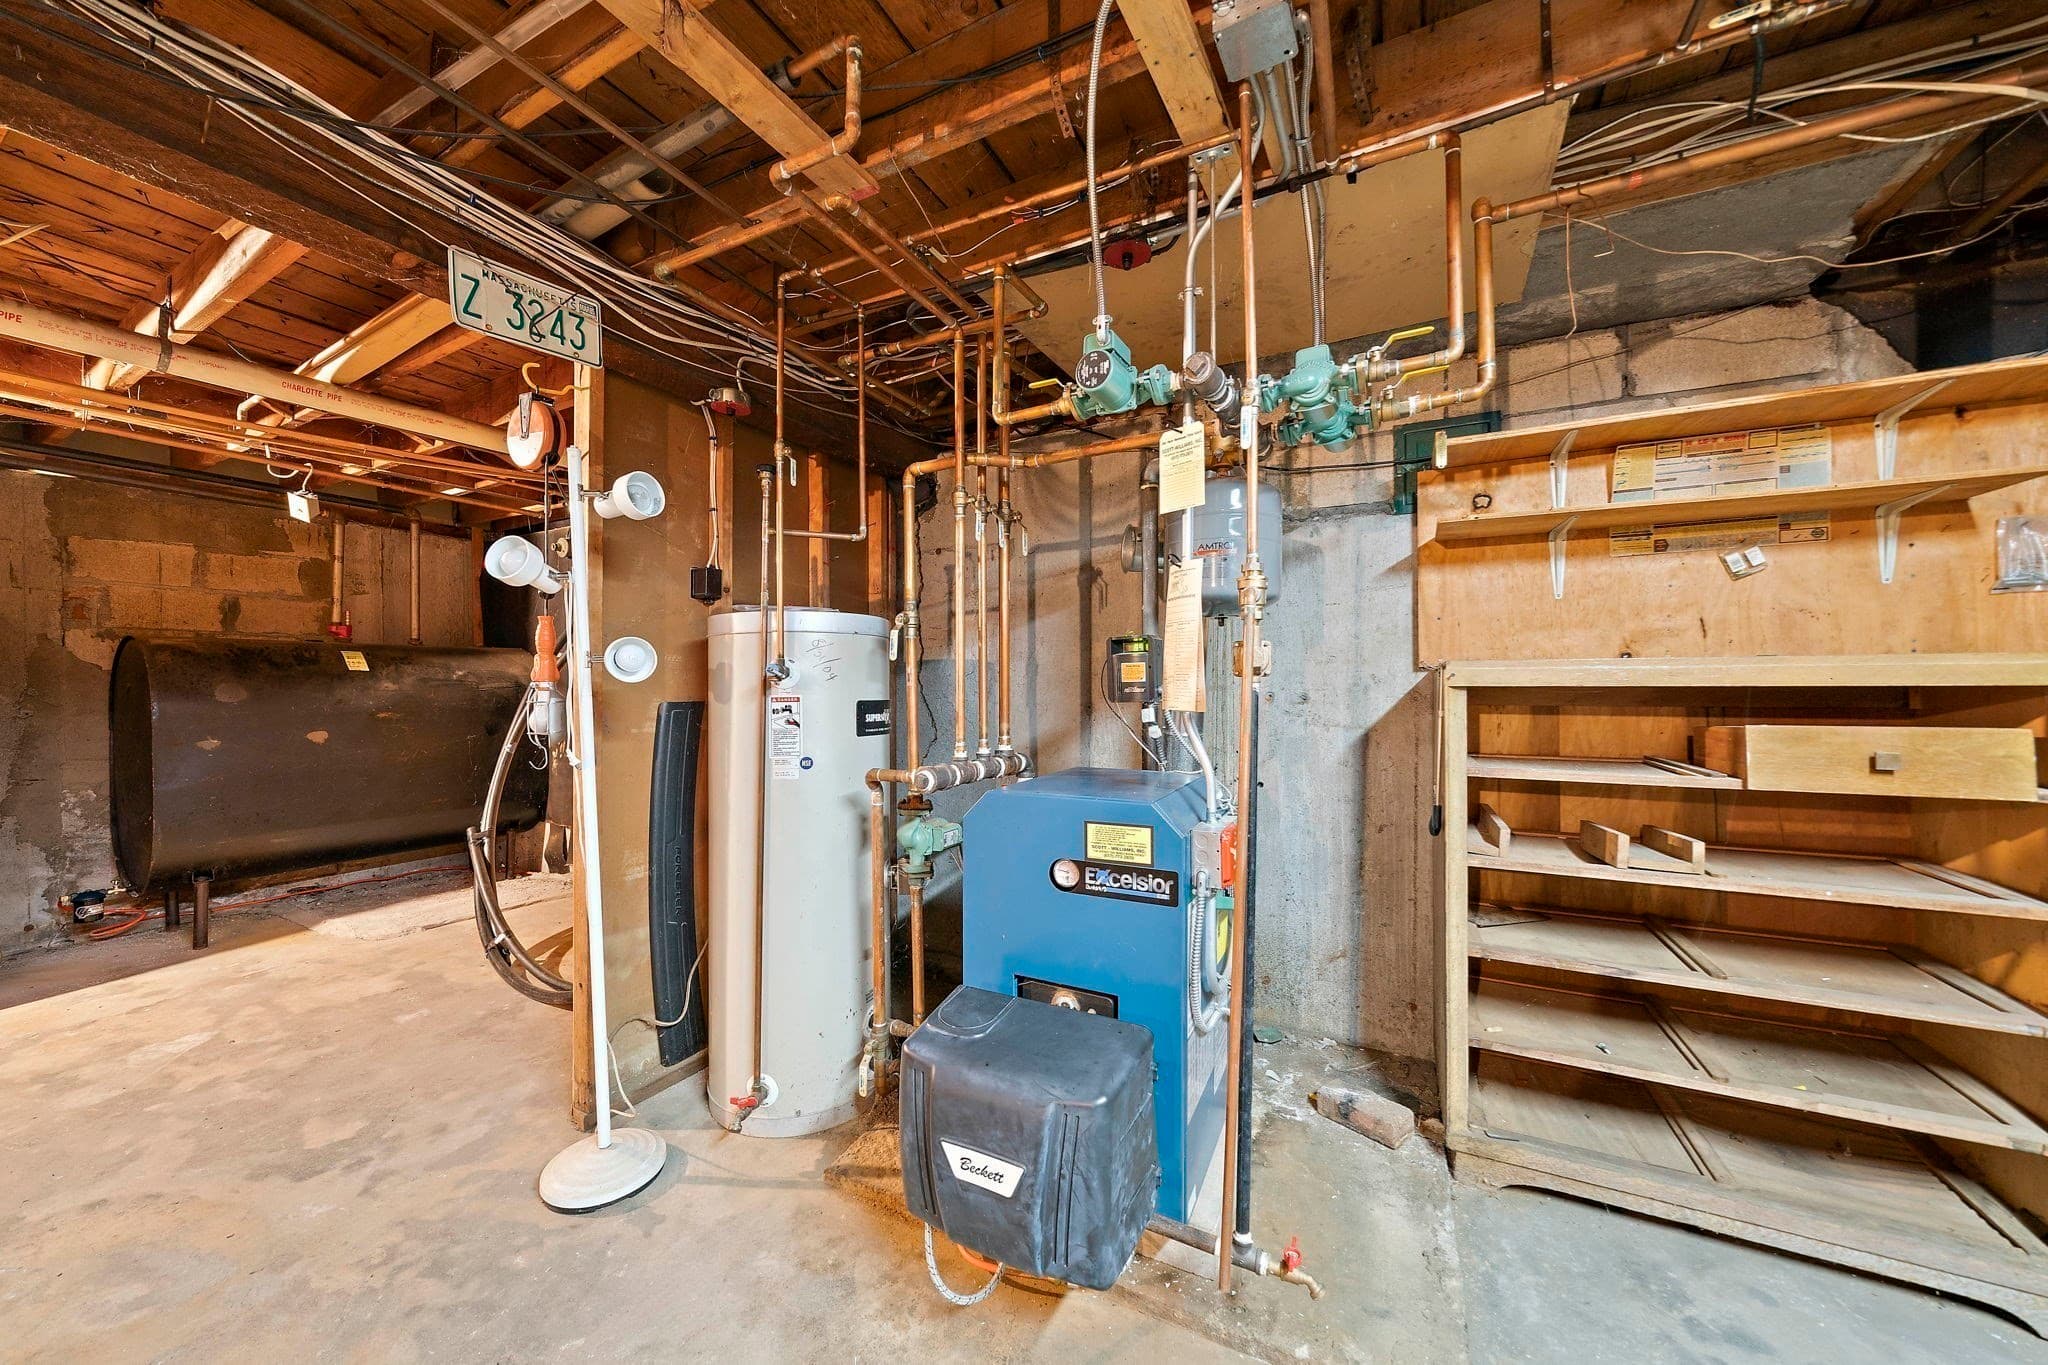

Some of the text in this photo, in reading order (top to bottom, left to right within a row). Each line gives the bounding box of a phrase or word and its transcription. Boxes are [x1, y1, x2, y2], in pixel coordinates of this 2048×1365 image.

[0, 311, 23, 324] PIPE
[461, 273, 586, 350] Z 3243
[281, 381, 343, 402] CHARLOTTE PIPE
[1198, 541, 1233, 551] AMTRO
[960, 1157, 1005, 1183] Beckett
